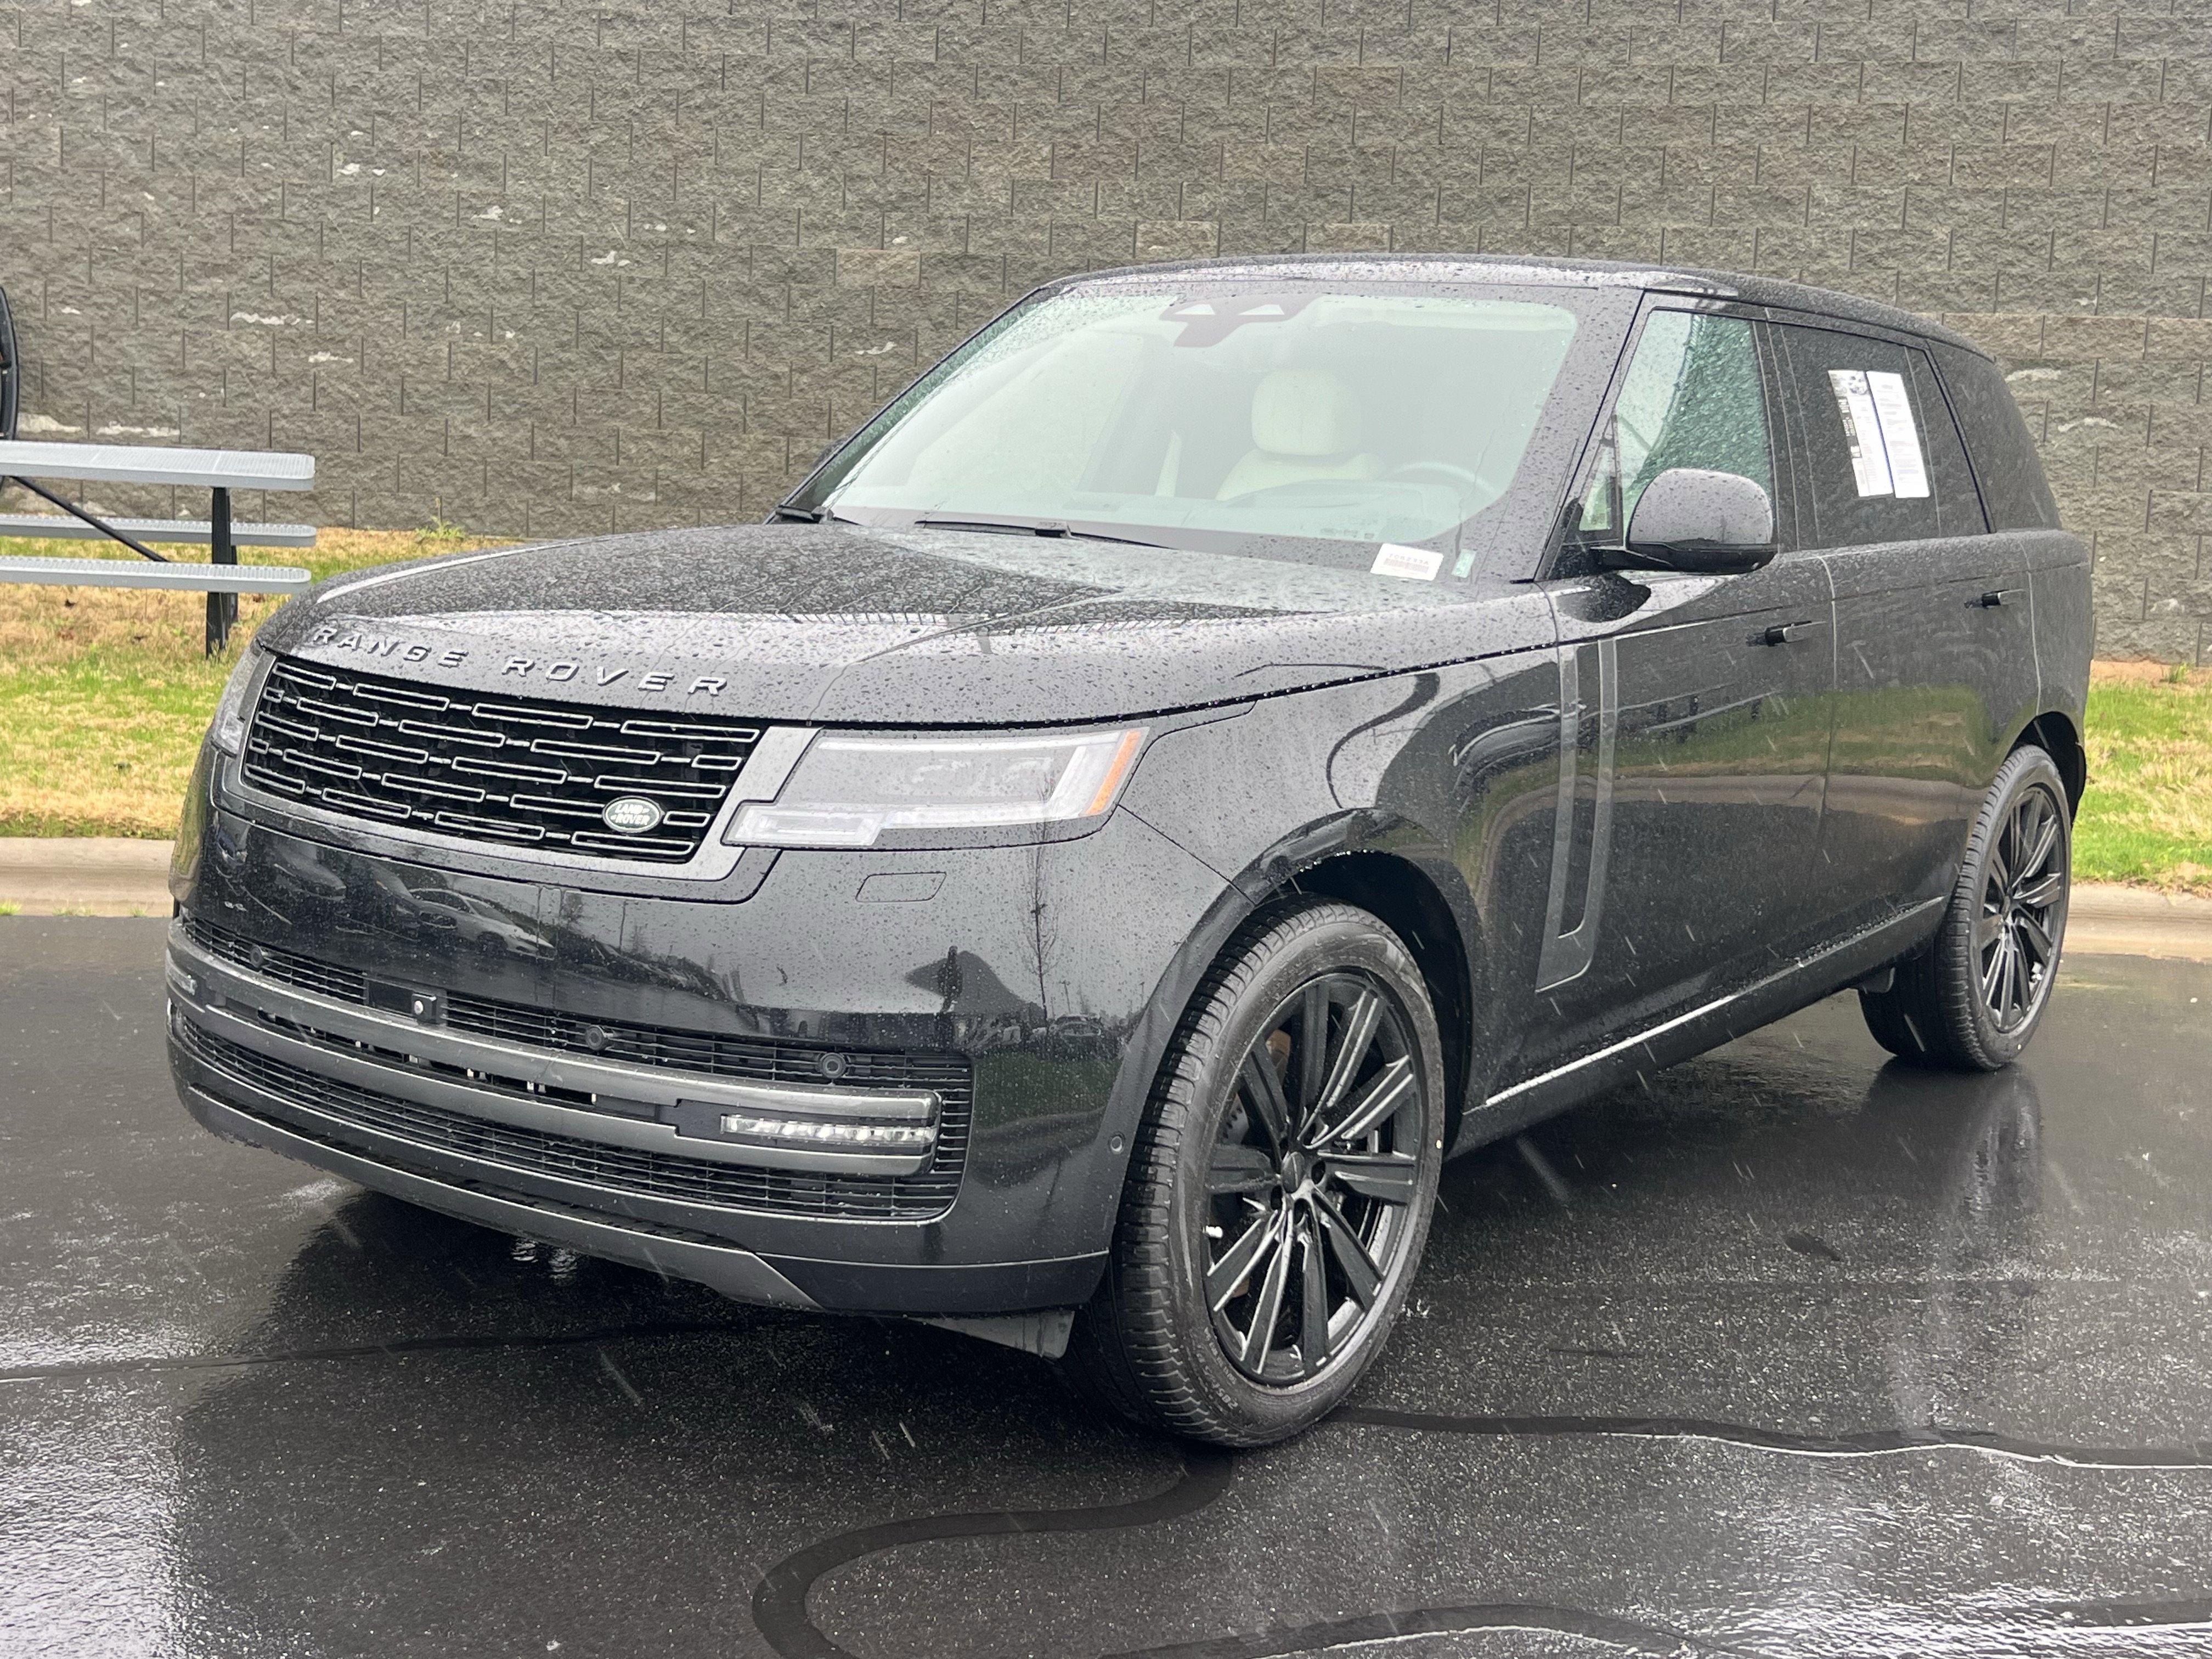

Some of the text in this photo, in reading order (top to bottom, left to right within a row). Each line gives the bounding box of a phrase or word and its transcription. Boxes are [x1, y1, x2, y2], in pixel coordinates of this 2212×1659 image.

[313, 626, 727, 696] RANGE ROVER
[614, 803, 644, 814] LAND
[615, 813, 651, 826] ROVER
